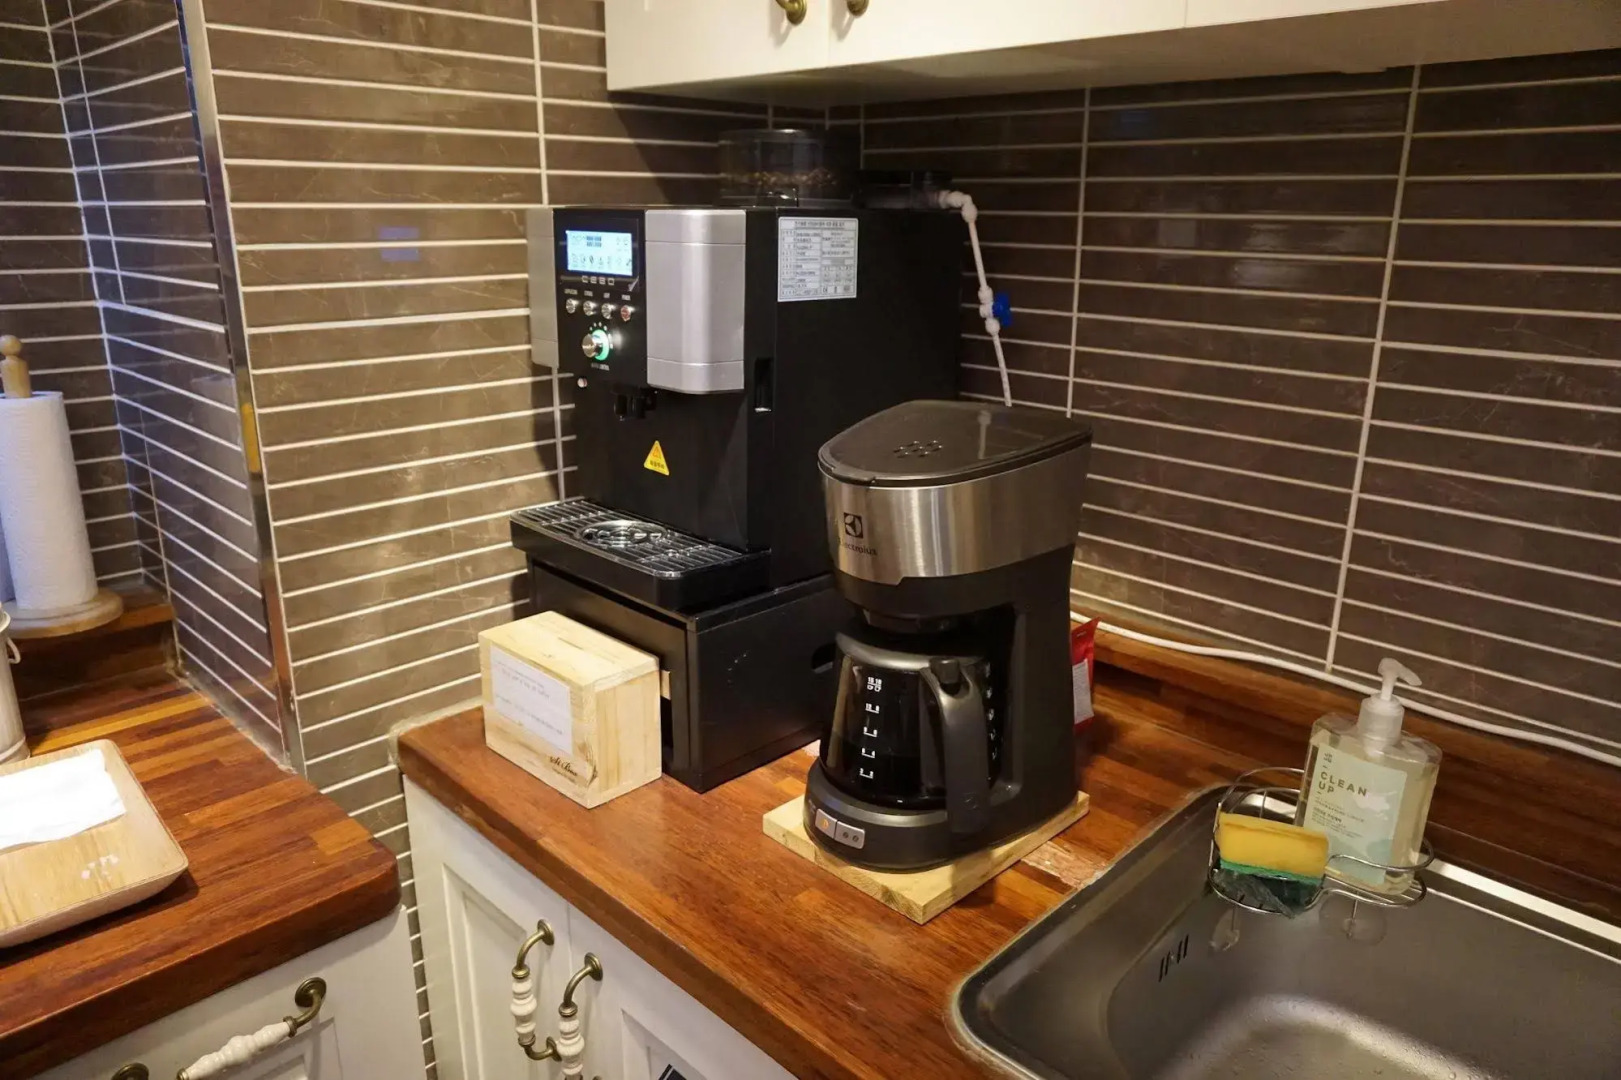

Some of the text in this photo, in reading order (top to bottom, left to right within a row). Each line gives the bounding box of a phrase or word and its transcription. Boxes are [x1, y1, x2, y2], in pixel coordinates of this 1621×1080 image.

[840, 541, 878, 556] ectrolux
[1318, 781, 1335, 793] UP
[1320, 771, 1367, 797] CLEAN
